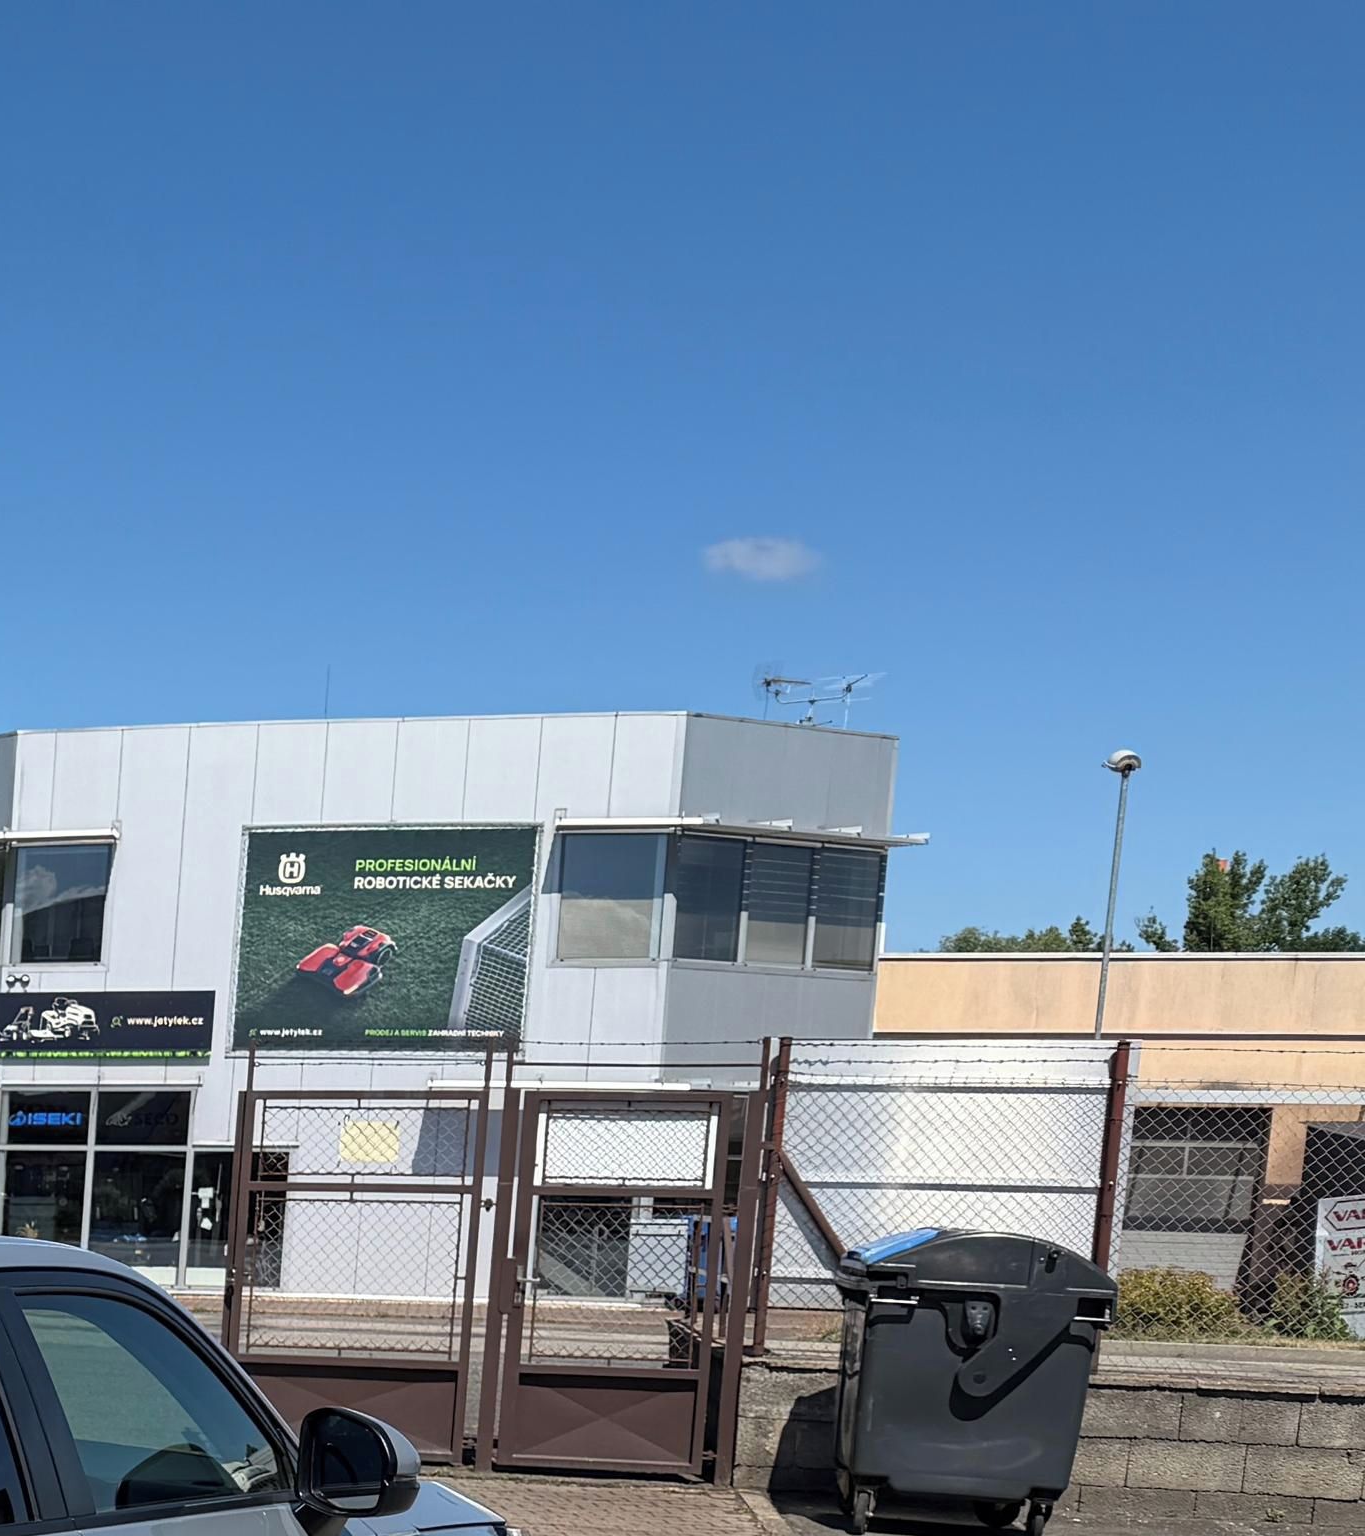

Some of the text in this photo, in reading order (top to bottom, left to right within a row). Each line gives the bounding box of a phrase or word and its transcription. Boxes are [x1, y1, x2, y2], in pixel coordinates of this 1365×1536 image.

[355, 855, 477, 872] PROFESIONÁLNÍ
[353, 872, 517, 889] ROBOTICKÉ SEKAČKY
[259, 884, 321, 897] Husqvarna
[126, 1015, 204, 1027] www.jetylek.cz
[27, 1112, 83, 1126] ISEKI
